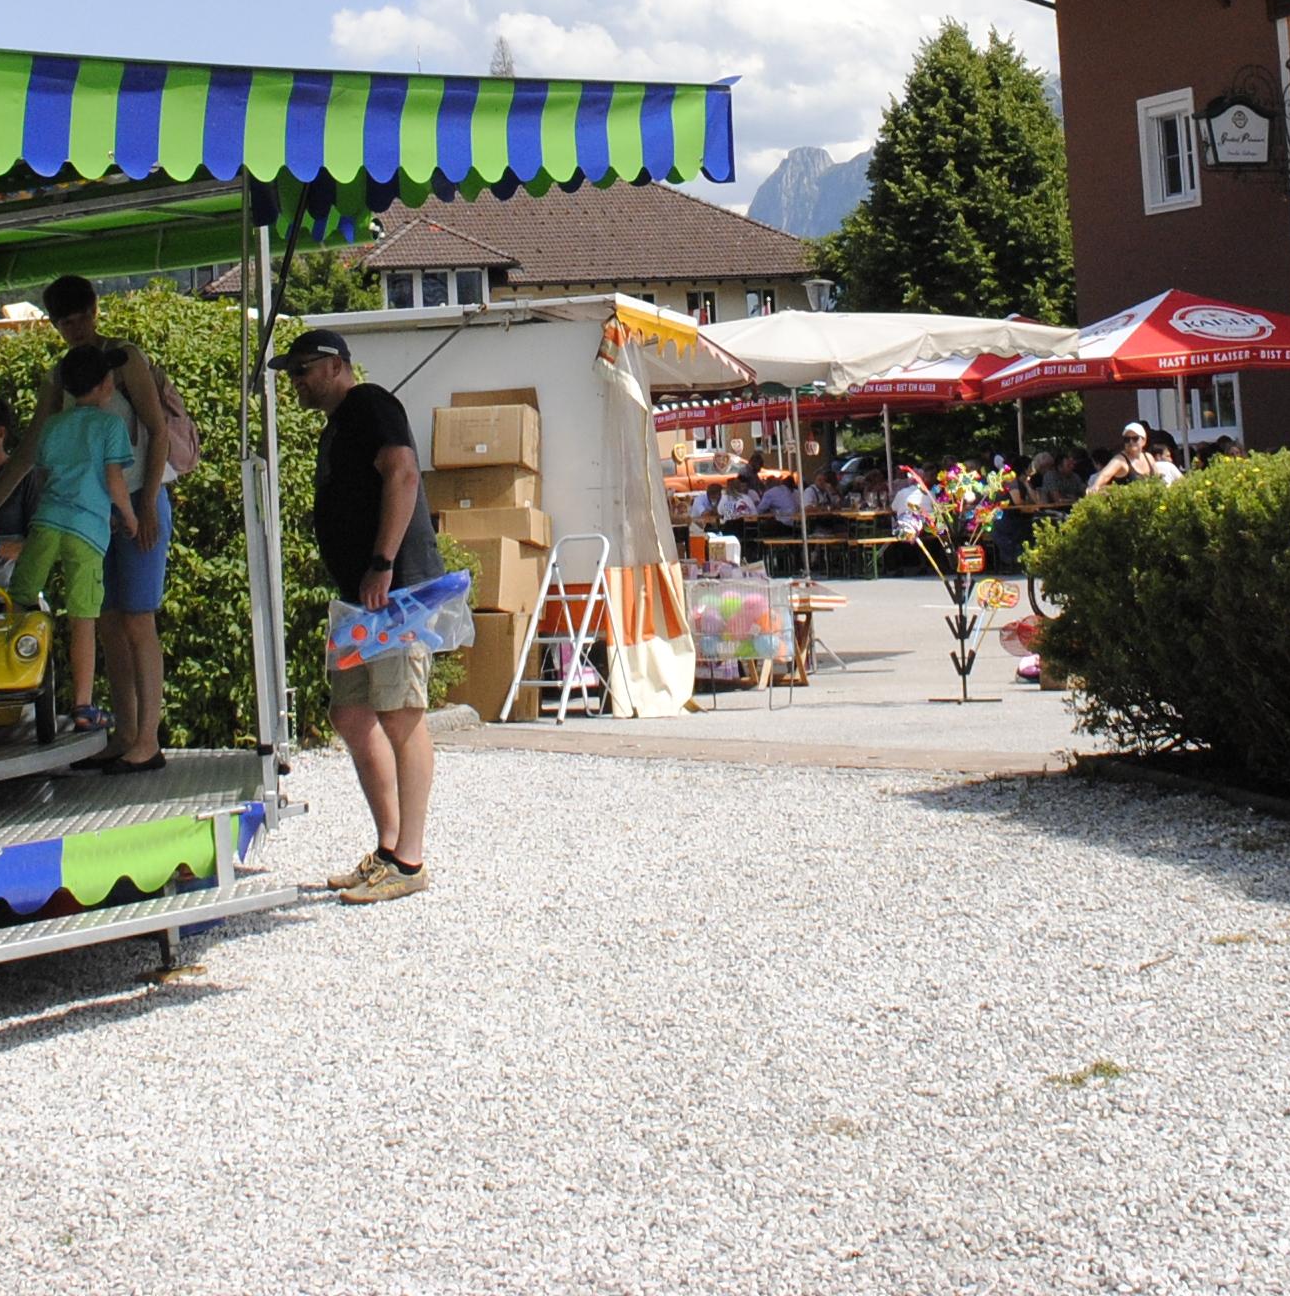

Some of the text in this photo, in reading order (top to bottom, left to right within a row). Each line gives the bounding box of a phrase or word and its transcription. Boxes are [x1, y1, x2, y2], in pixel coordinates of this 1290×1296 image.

[1182, 317, 1261, 329] KAISER
[1158, 355, 1187, 369] HAST
[1190, 353, 1209, 365] EIN
[1213, 350, 1250, 363] KAISER
[1260, 349, 1281, 360] BIST
[1044, 365, 1057, 375] BIST
[1058, 364, 1068, 374] EIN
[1069, 363, 1087, 374] KAISER
